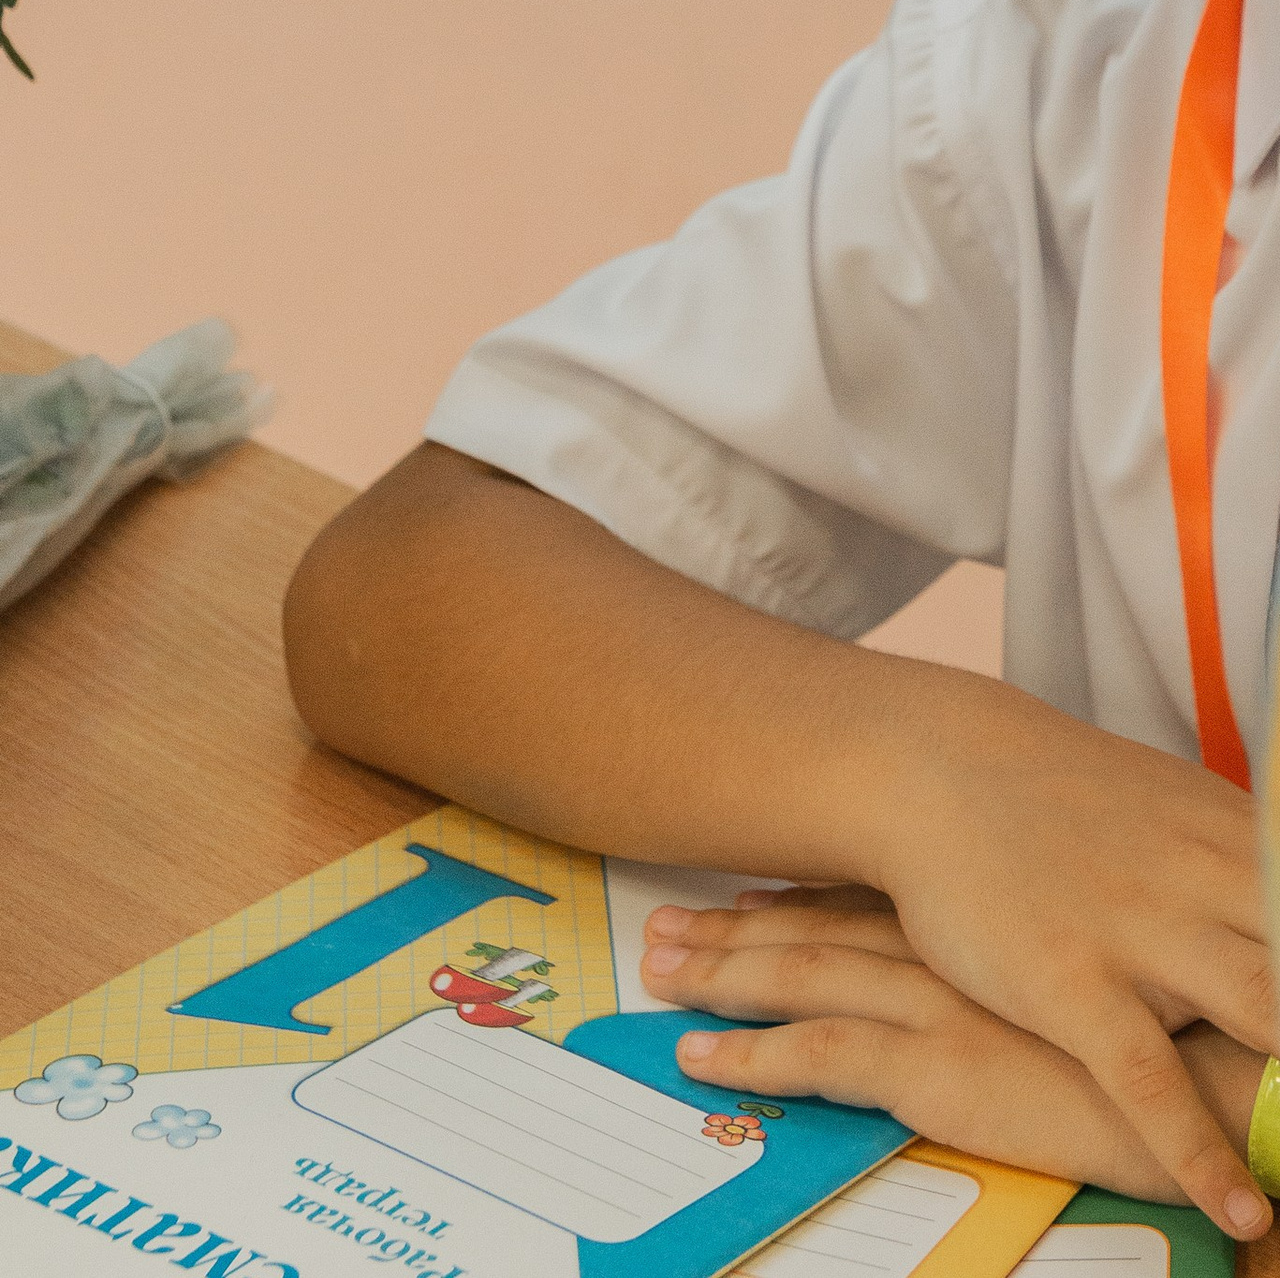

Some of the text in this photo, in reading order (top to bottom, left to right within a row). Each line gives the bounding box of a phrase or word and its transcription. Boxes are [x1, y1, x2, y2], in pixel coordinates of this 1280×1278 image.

[165, 842, 558, 1035] 1
[0, 1136, 301, 1278] матик
[293, 1157, 455, 1241] тетрадь
